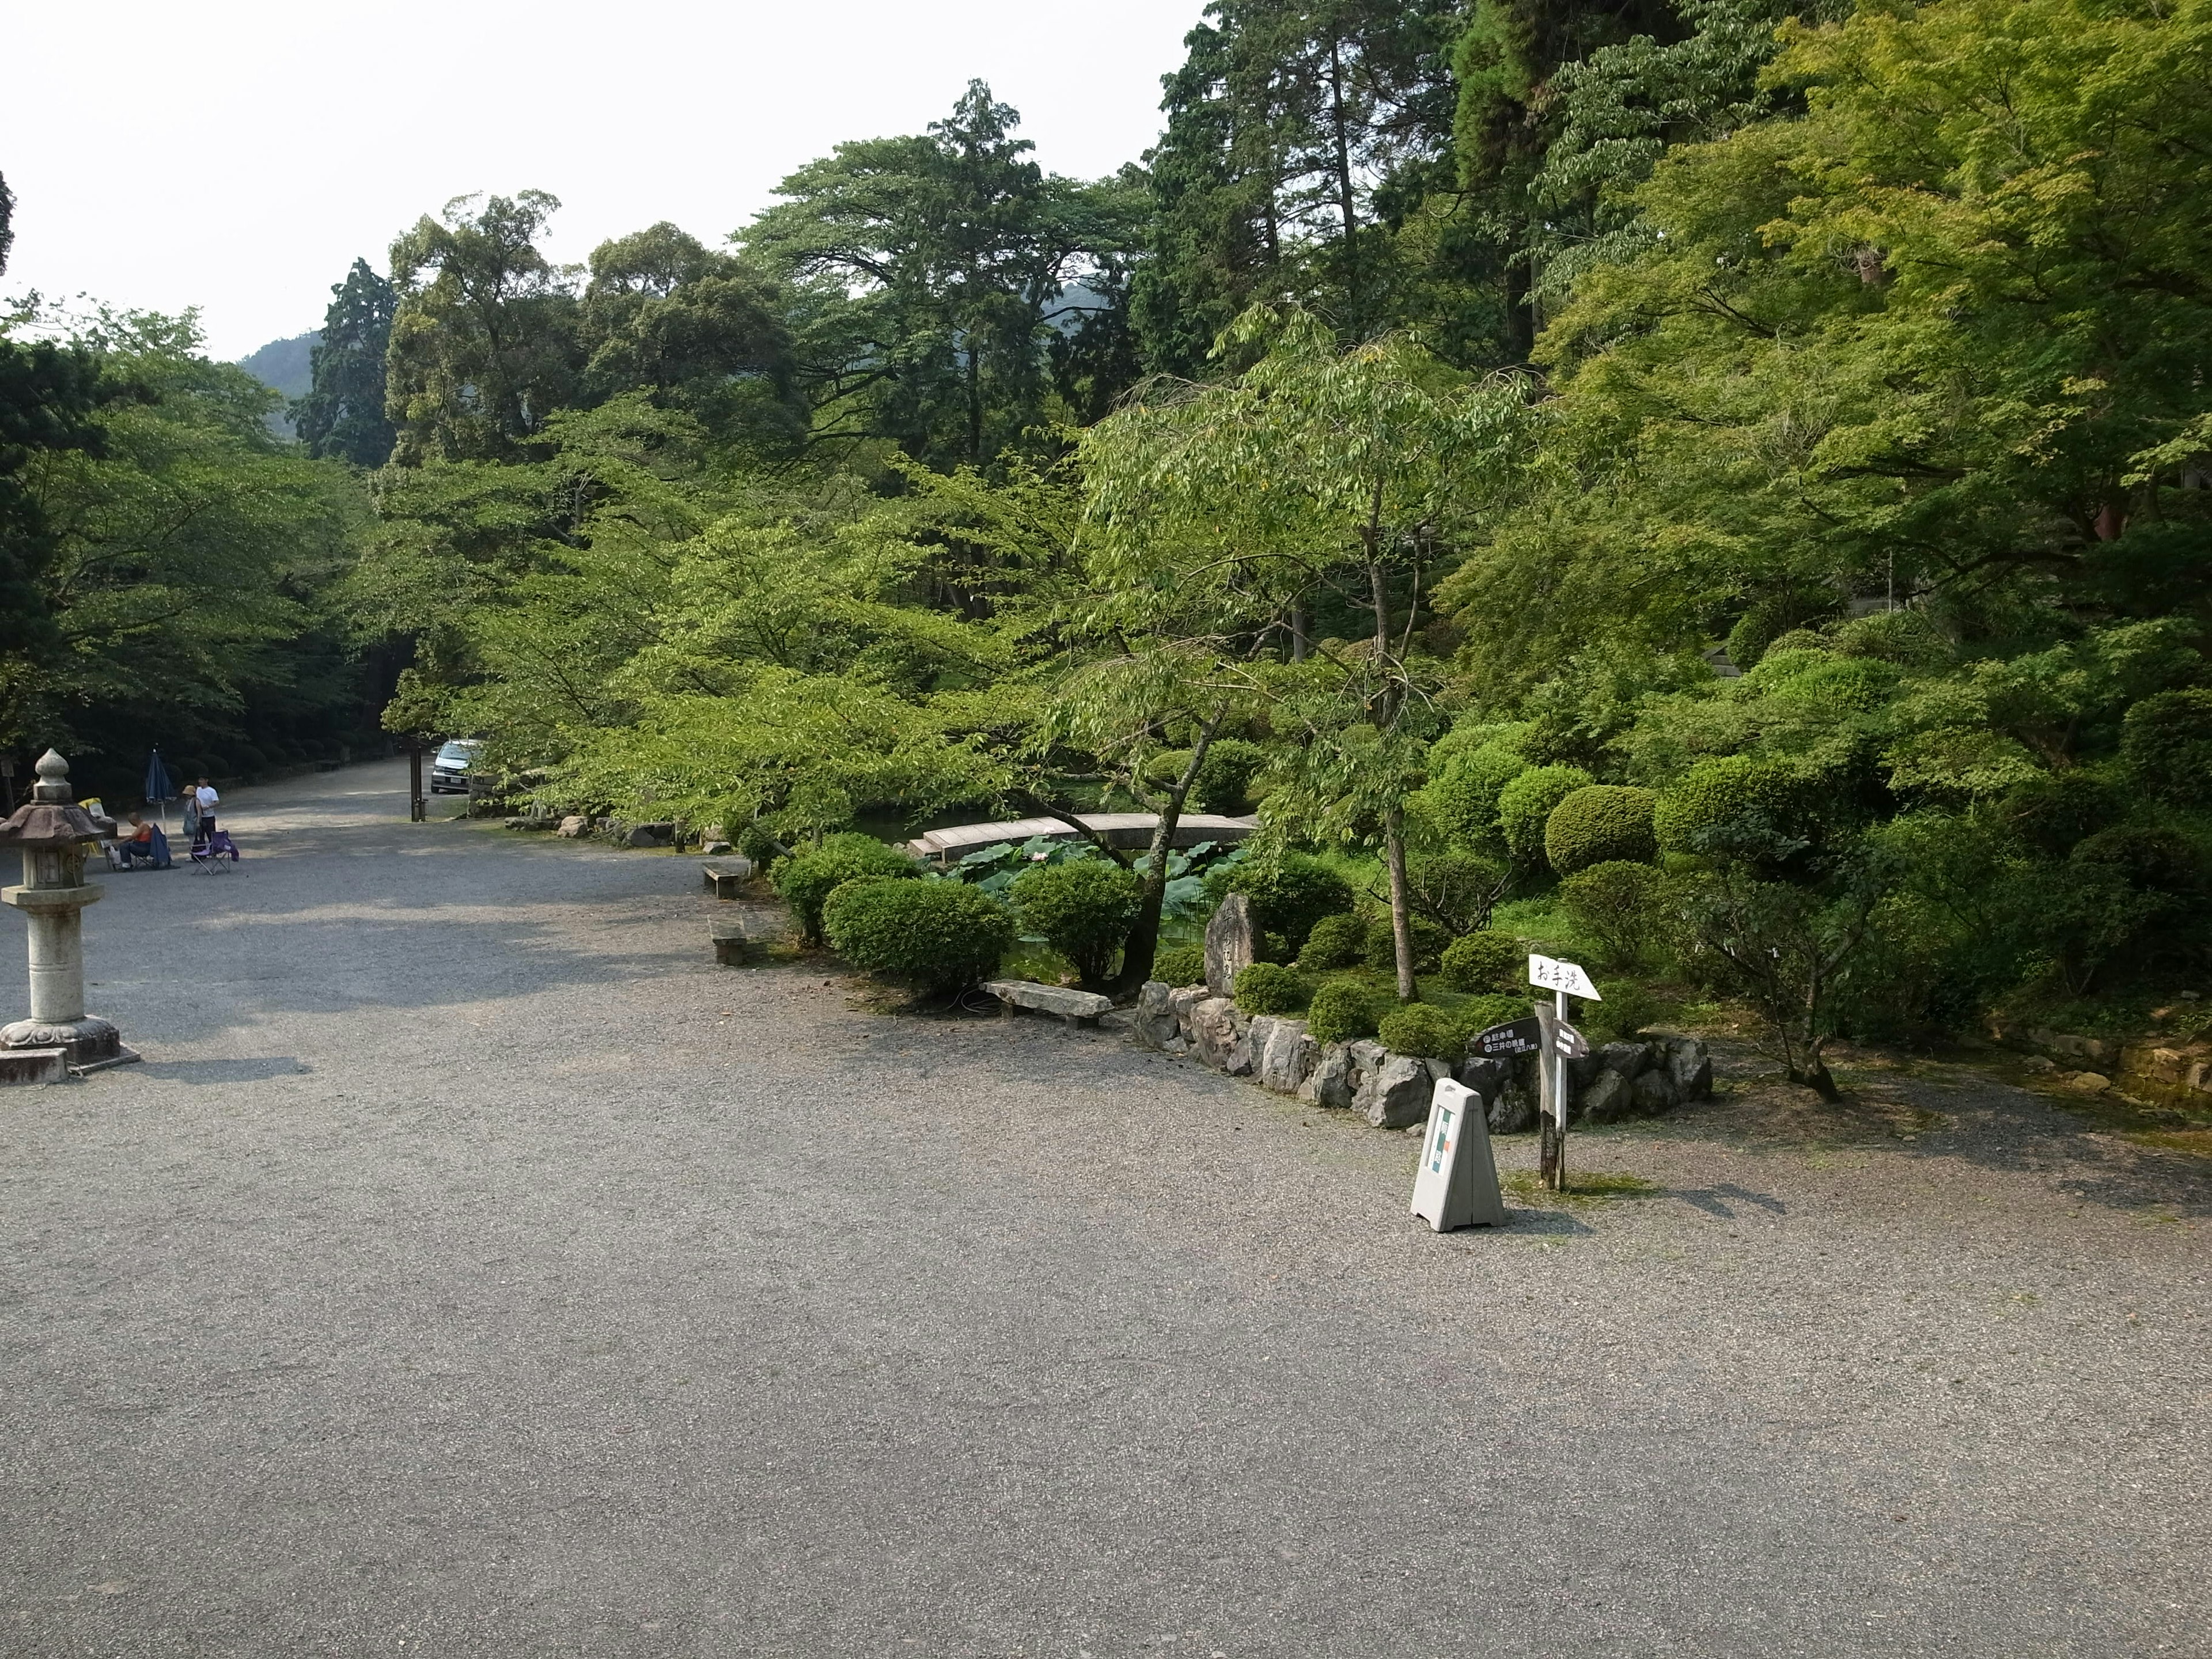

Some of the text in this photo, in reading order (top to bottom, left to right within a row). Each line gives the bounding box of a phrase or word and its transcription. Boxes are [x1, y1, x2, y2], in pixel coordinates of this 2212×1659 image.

[1537, 961, 1580, 990] お手洗
[1491, 1029, 1514, 1041] 駐車場
